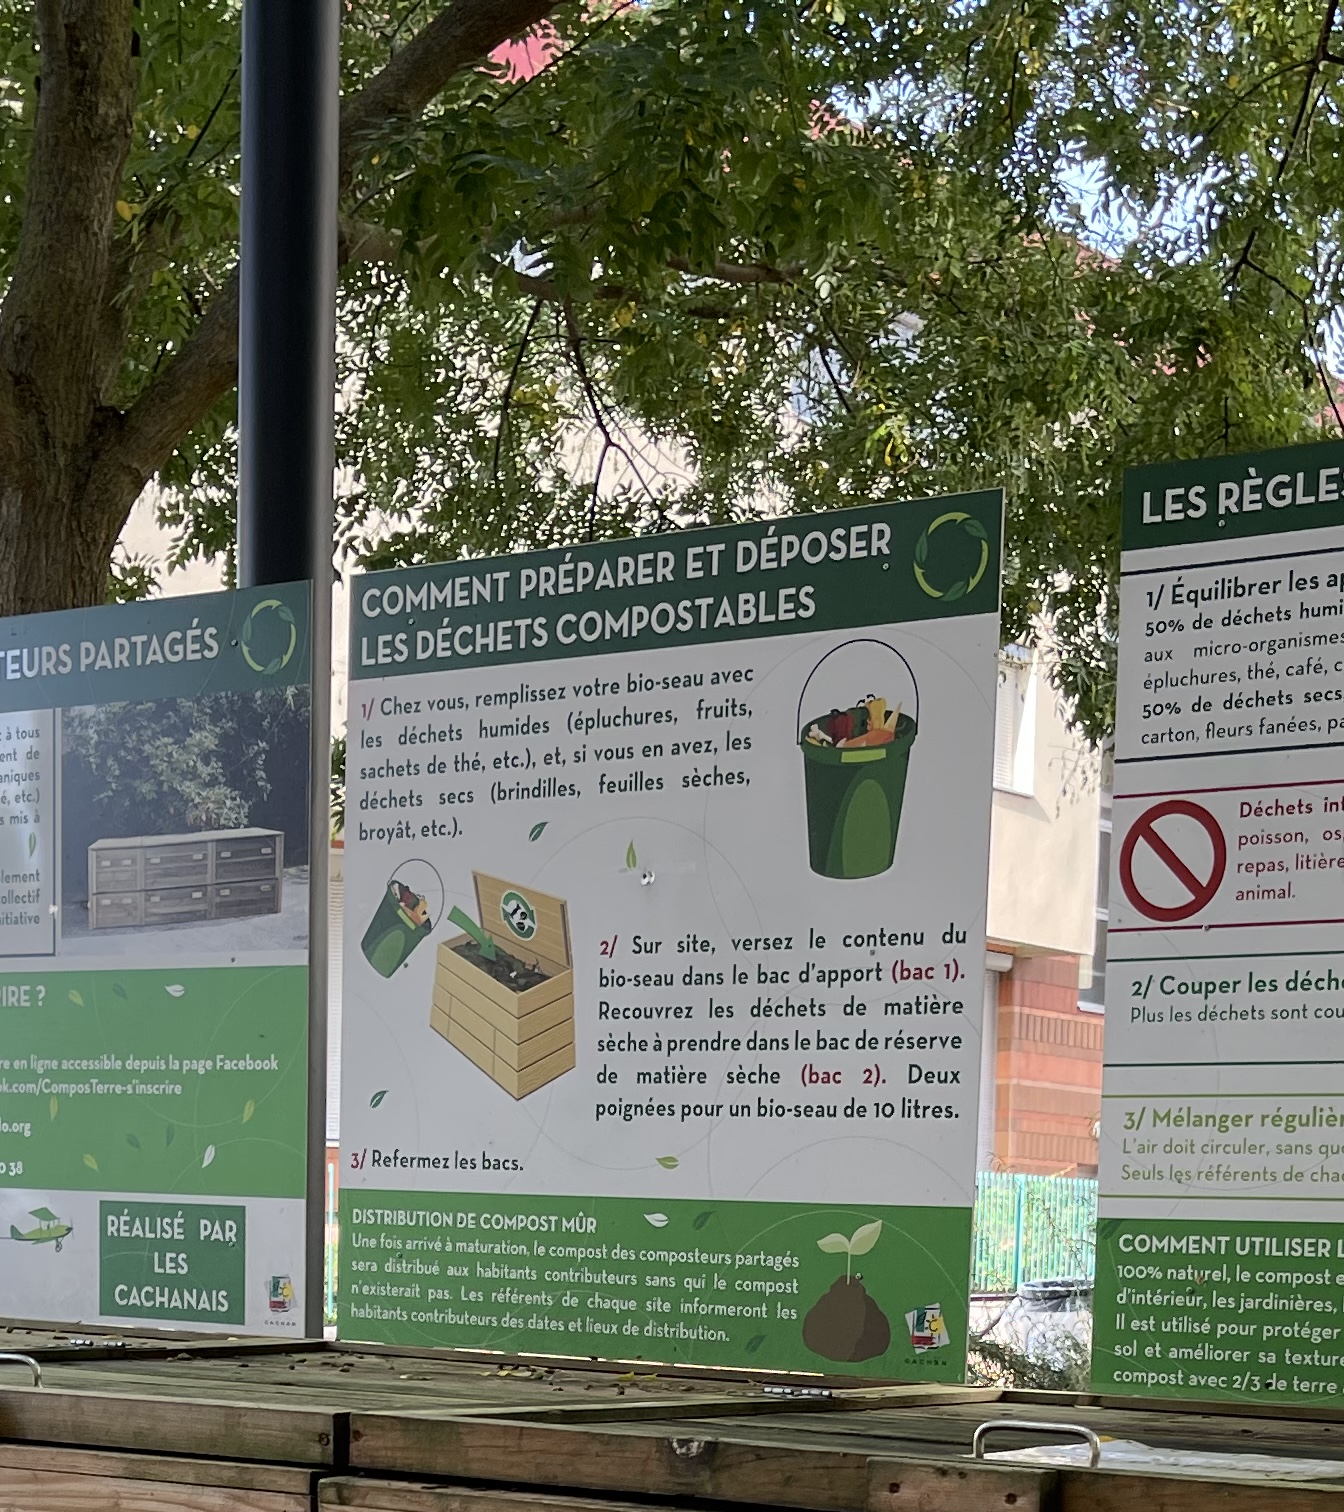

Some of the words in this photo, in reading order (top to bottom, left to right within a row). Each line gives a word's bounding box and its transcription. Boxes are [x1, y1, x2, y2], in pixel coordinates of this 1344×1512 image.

[1141, 484, 1207, 524] LES
[361, 571, 511, 618] COMMENT
[519, 552, 675, 600] PRÉPARER
[685, 543, 727, 580] ET
[735, 523, 892, 573] DÉPOSER
[1170, 574, 1282, 609] Équilibrer
[1287, 568, 1320, 592] les
[361, 633, 407, 667] LES
[416, 617, 549, 661] DÉCHETS
[556, 585, 817, 645] COMPOSTABLES
[80, 618, 219, 673] PARTAGÉS
[379, 694, 421, 716] Chez
[426, 695, 469, 711] vous,
[474, 681, 566, 710] remplissez
[571, 676, 620, 698] votre
[626, 671, 704, 693] bio-seau
[709, 667, 754, 686] avec
[4, 730, 12, 741] à
[14, 726, 41, 740] tous
[359, 728, 383, 749] les
[397, 722, 463, 746] déchets
[478, 713, 550, 739] humides
[566, 704, 678, 736] (épluchures,
[695, 696, 753, 720] fruits,
[1140, 725, 1200, 745] carton,
[1204, 720, 1253, 739] fleurs
[1257, 714, 1322, 736] fanées,
[1237, 827, 1309, 851] poisson,
[1234, 879, 1296, 901] animal.
[598, 933, 618, 959] 2/
[630, 934, 663, 955] Sur
[675, 932, 716, 955] site,
[730, 935, 793, 951] versez
[808, 926, 826, 949] le
[841, 926, 924, 948] contenu
[940, 921, 967, 945] du
[1130, 973, 1154, 1000] 2/
[1158, 974, 1242, 1001] Couper
[1247, 970, 1279, 993] les
[1122, 1105, 1147, 1131] 3/
[1151, 1105, 1254, 1134] Mélanger
[7, 1159, 24, 1177] 38
[349, 1147, 368, 1170] 3/
[370, 1147, 450, 1169] Refermez
[453, 1149, 477, 1170] les
[481, 1149, 524, 1171] bacs.
[106, 1213, 185, 1240] RÉALISÉ
[198, 1217, 237, 1242] PAR
[351, 1207, 453, 1228] DISTRIBUTION
[455, 1211, 477, 1229] DE
[478, 1212, 559, 1232] COMPOST
[560, 1210, 597, 1234] MÛR
[1117, 1232, 1231, 1255] COMMENT
[1234, 1235, 1331, 1258] UTILISER
[152, 1250, 189, 1275] LES
[350, 1259, 378, 1272] sera
[383, 1256, 440, 1275] distribué
[445, 1264, 470, 1277] aux
[475, 1260, 538, 1281] habitants
[543, 1265, 638, 1286] contributeurs
[644, 1274, 676, 1288] sans
[682, 1272, 706, 1293] qui
[712, 1271, 727, 1290] le
[734, 1277, 799, 1297] compost
[1116, 1264, 1163, 1280] 100%
[1165, 1262, 1231, 1285] naturel,
[1234, 1263, 1251, 1283] le
[1254, 1267, 1332, 1289] compost
[113, 1283, 229, 1312] CACHANAIS
